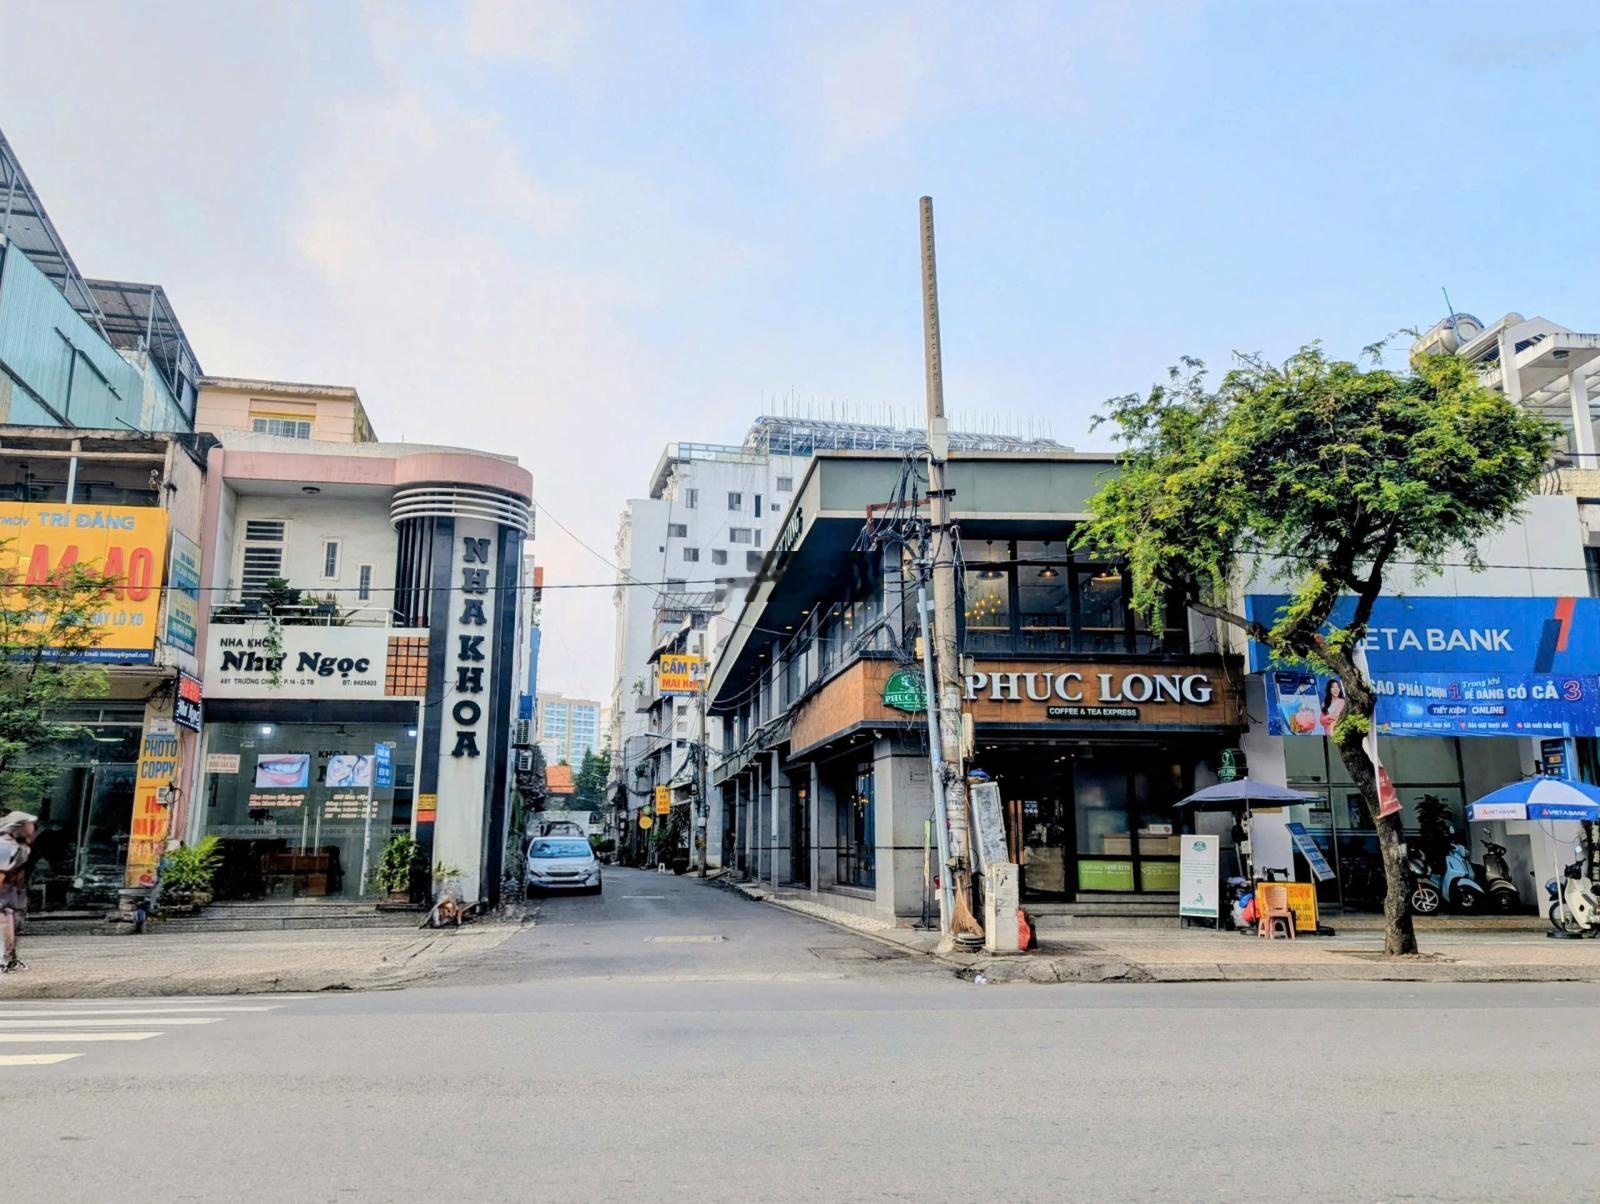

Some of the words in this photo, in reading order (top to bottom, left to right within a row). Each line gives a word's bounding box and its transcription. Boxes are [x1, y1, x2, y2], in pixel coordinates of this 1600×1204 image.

[459, 536, 491, 626] NHA
[220, 637, 244, 648] NHA
[220, 650, 288, 672] Như
[296, 652, 370, 677] Ngọc
[962, 671, 1082, 702] PHUC
[1097, 674, 1213, 703] LONG
[1398, 680, 1424, 697] PHẢI
[1449, 682, 1462, 700] 1
[1487, 676, 1500, 686] khi
[1507, 683, 1528, 700] CÓ
[1532, 680, 1560, 699] CẢ
[1563, 680, 1582, 701] 3
[451, 635, 486, 759] KHOA
[1049, 707, 1079, 716] COFFEE
[1087, 708, 1102, 716] TEA
[1103, 708, 1137, 717] EXPRESS
[1472, 706, 1505, 715] ONLINE
[143, 740, 178, 758] PHOTO
[141, 761, 177, 779] COPPY
